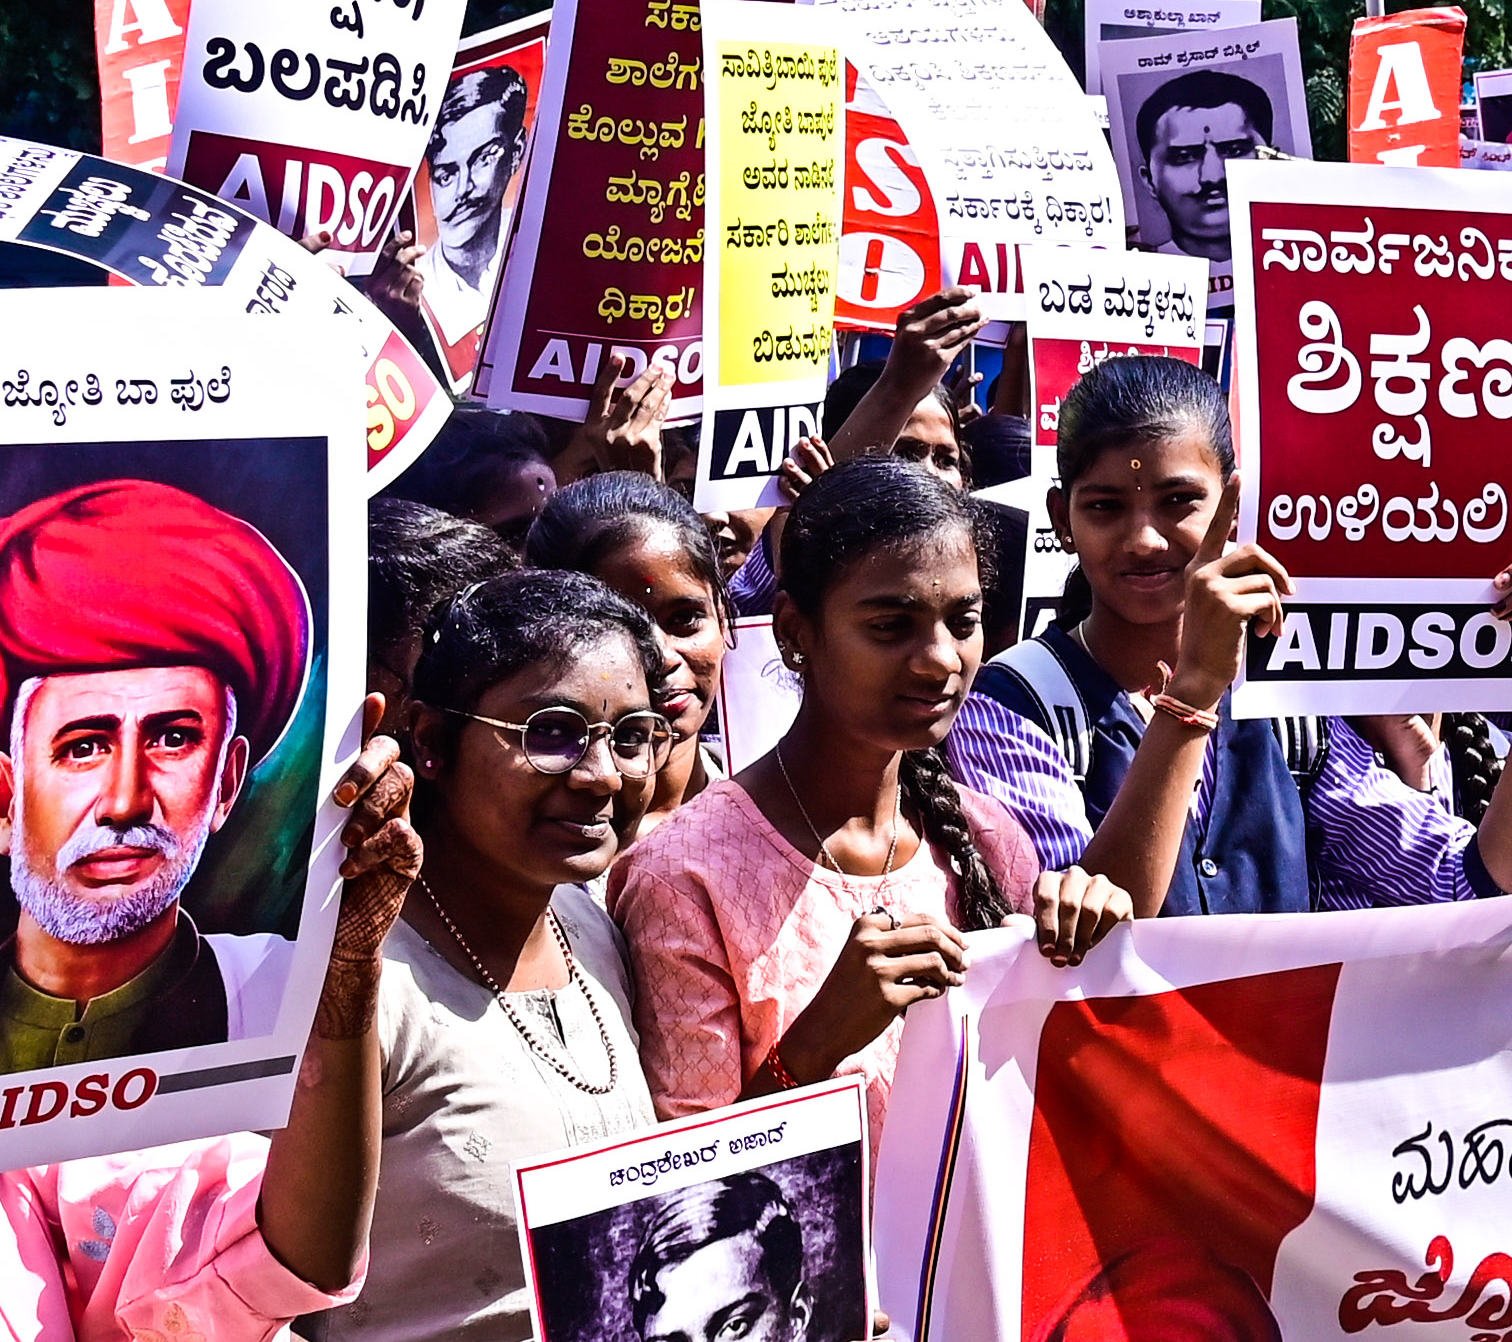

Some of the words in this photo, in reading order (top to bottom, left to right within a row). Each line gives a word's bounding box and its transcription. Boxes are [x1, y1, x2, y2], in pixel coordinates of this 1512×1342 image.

[1137, 53, 1173, 68] ರಾಮ್
[743, 158, 789, 190] ಅವರ
[213, 152, 396, 251] AIDSO
[727, 217, 789, 248] ಸರ್ಕಾರಿ
[1039, 274, 1092, 313] ಬಡ
[1103, 277, 1197, 340] ಮಕ್ಕಳನ್ನು
[1, 369, 103, 426] ಜ್ಯೋತಿ
[115, 375, 158, 408] ಬಾ
[169, 365, 233, 413] ಫುಲೆ
[1267, 612, 1512, 671] AIDSO
[608, 1139, 720, 1187] ಚಂದ್ರಶೇಖರ್
